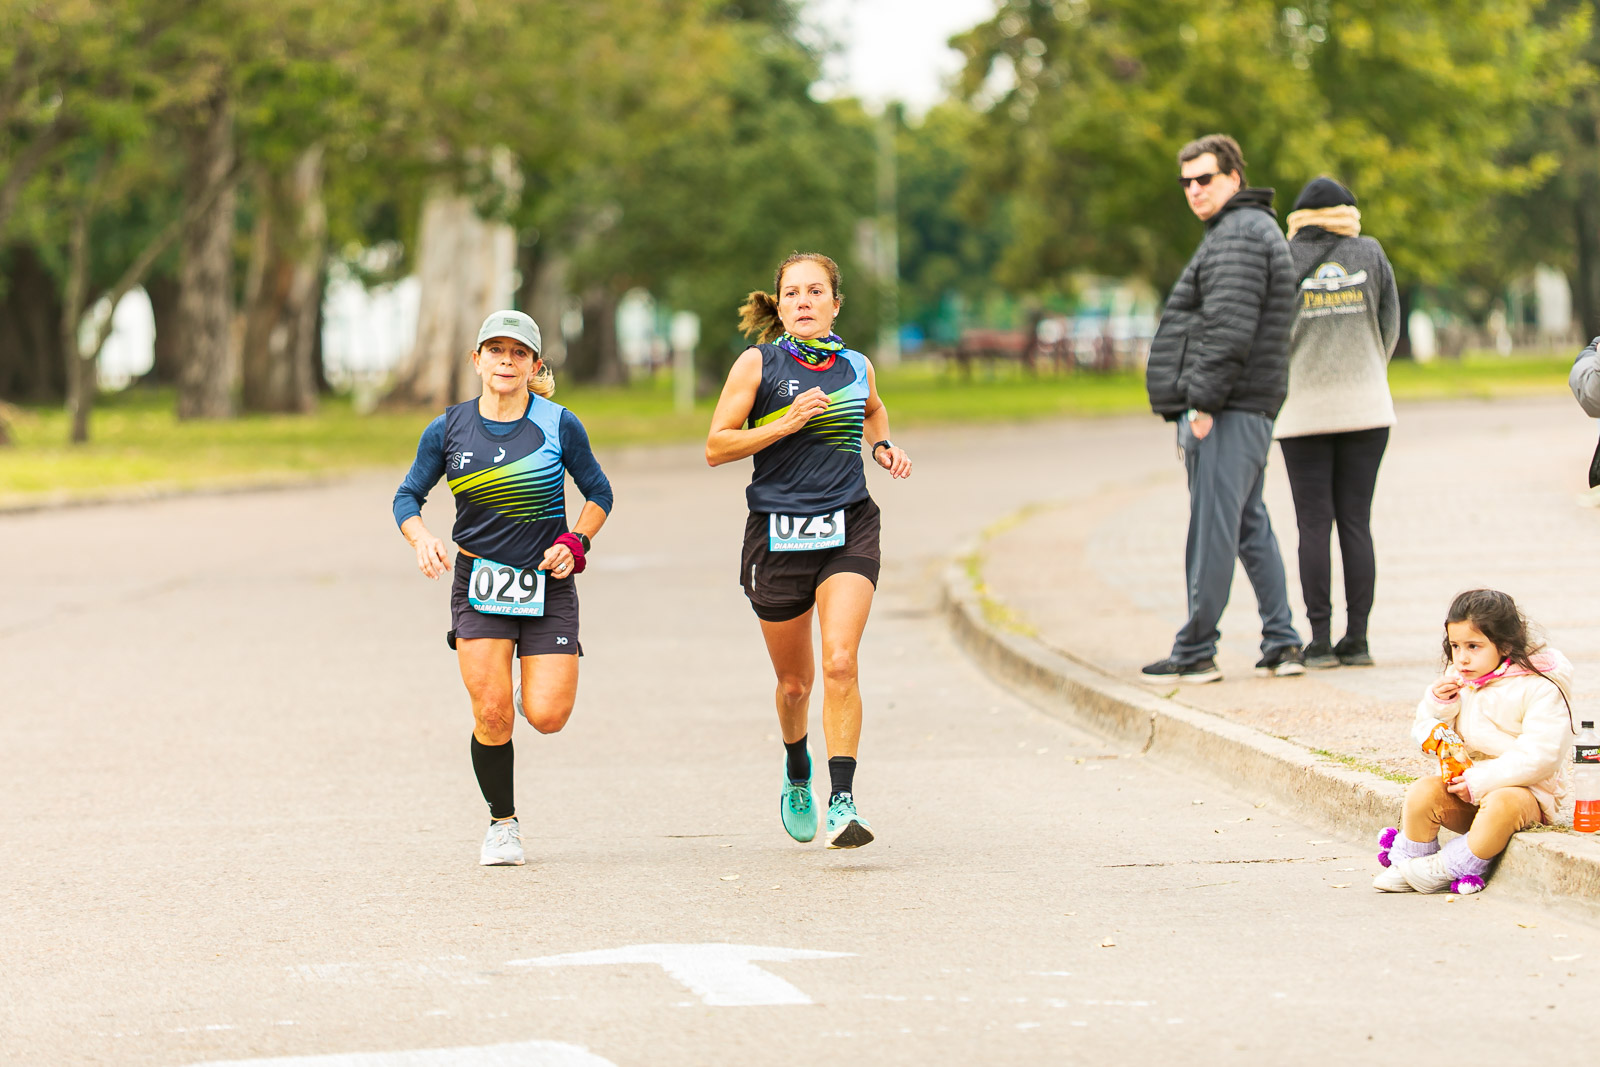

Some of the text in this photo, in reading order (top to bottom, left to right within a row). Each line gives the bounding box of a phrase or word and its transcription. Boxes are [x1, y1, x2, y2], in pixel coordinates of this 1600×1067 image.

[777, 379, 800, 398] SF
[451, 451, 474, 470] SF
[775, 511, 838, 539] 023
[773, 539, 841, 550] DIAMANTE CORRE
[474, 566, 538, 604] 029
[473, 603, 540, 615] DIAMANTE CORRE
